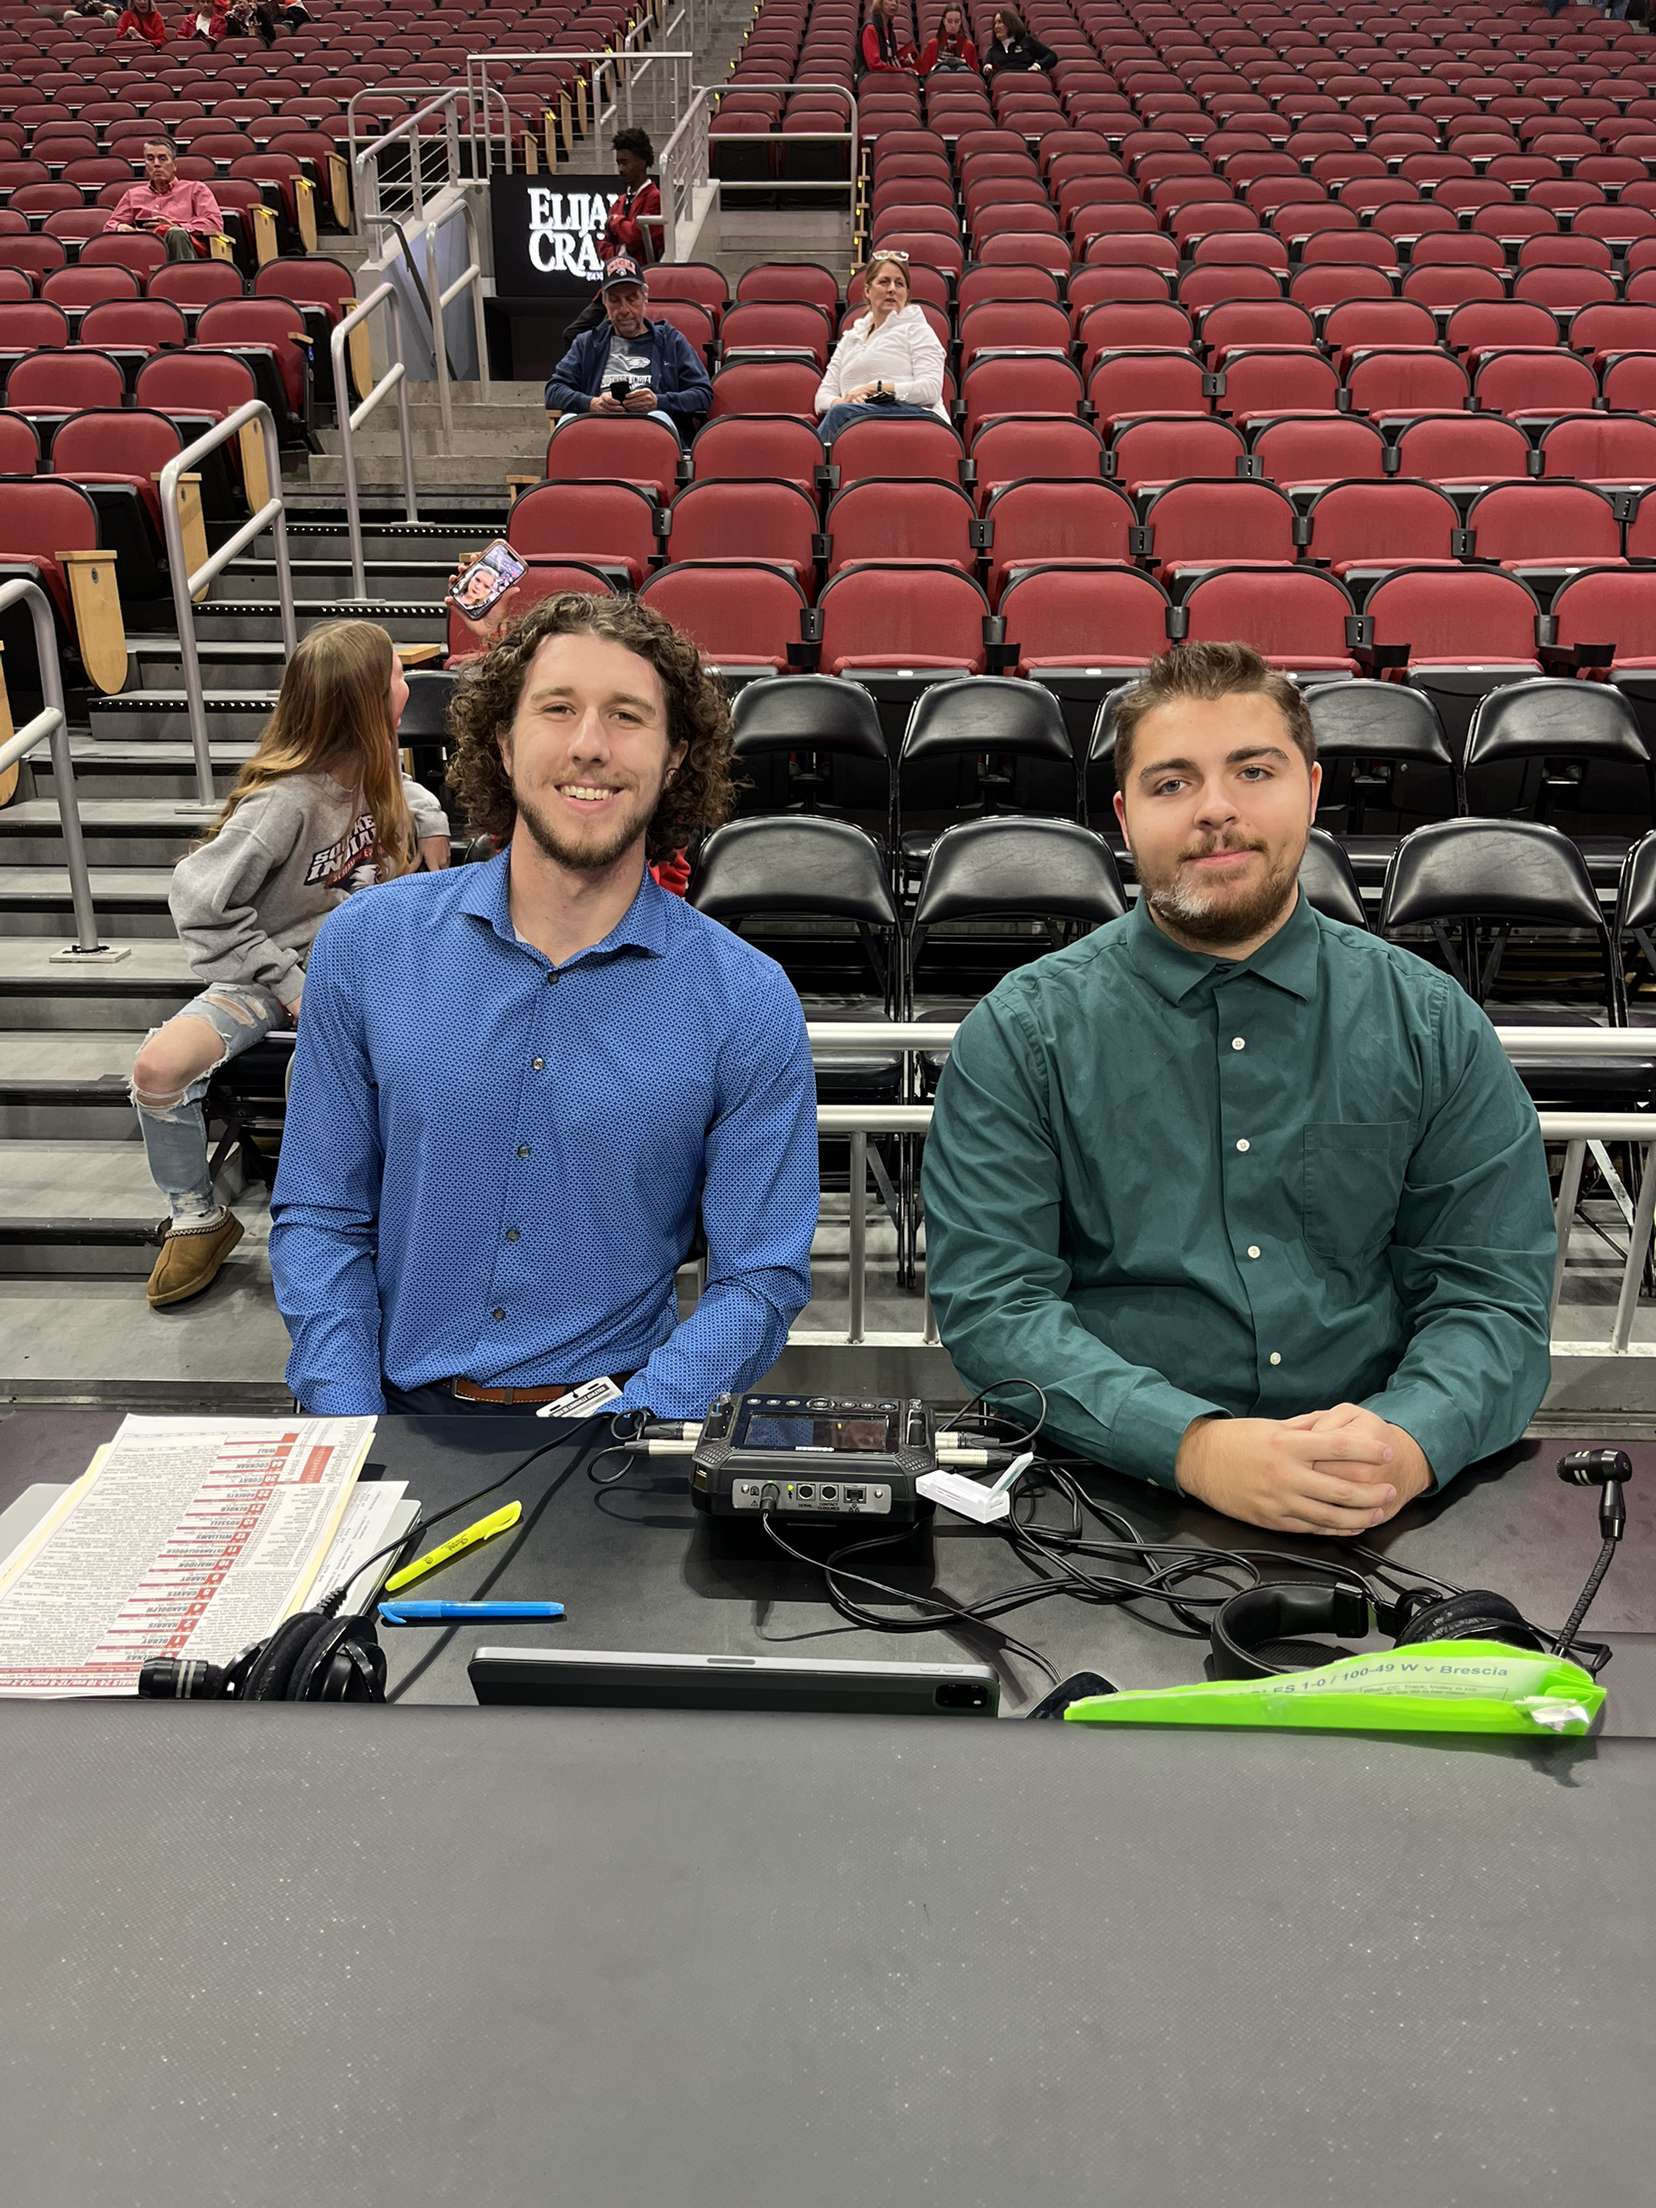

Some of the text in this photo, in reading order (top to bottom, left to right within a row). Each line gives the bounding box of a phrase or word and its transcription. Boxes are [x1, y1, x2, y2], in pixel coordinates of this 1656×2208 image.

[528, 230, 606, 278] CRA
[1343, 1664, 1394, 1681] 100-49
[1401, 1663, 1419, 1672] W
[1439, 1664, 1508, 1676] Brescia
